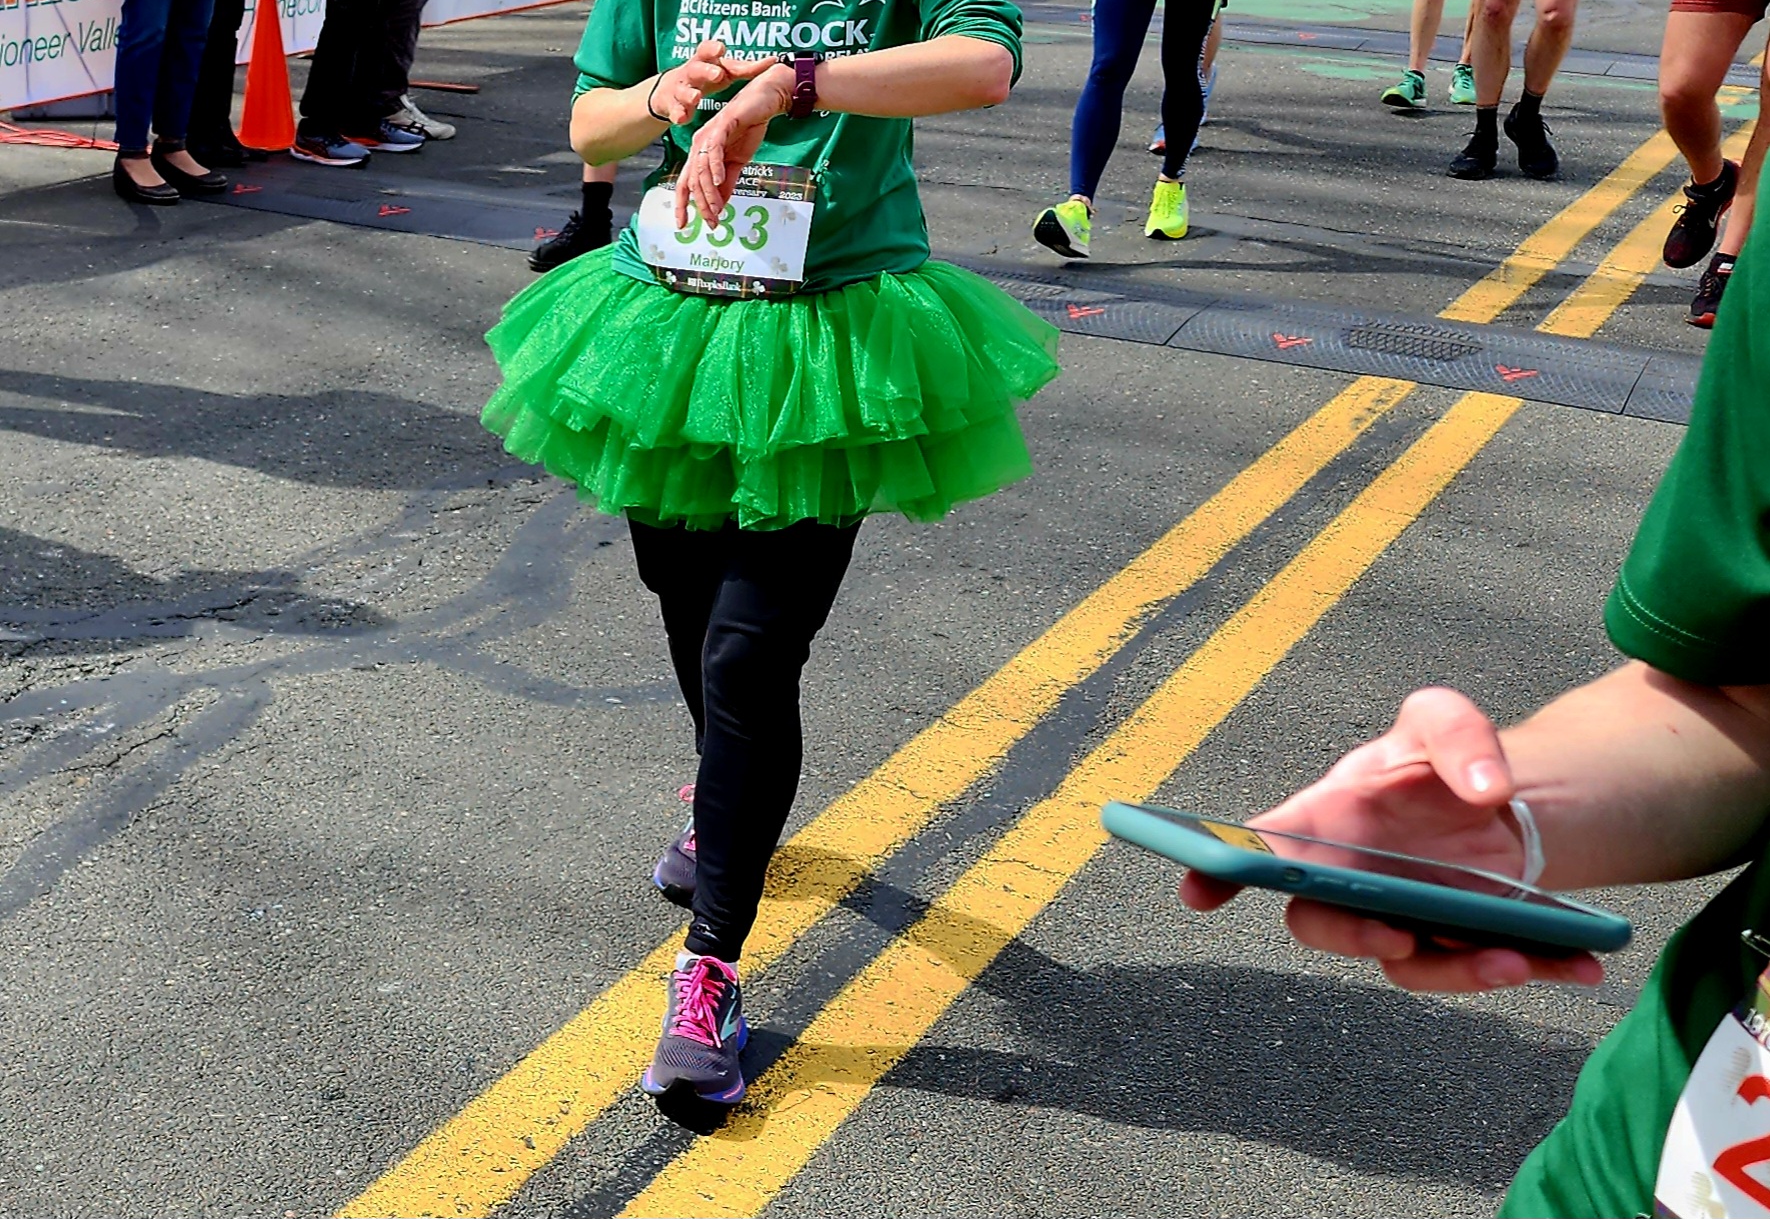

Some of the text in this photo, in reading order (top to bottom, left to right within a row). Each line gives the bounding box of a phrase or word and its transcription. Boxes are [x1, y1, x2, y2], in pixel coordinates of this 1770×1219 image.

[751, 0, 791, 17] Bank
[675, 17, 869, 48] SHAMROCK
[741, 165, 774, 178] atrick's
[735, 177, 760, 187] ACE
[778, 191, 803, 201] 2023
[690, 253, 745, 273] Marjory
